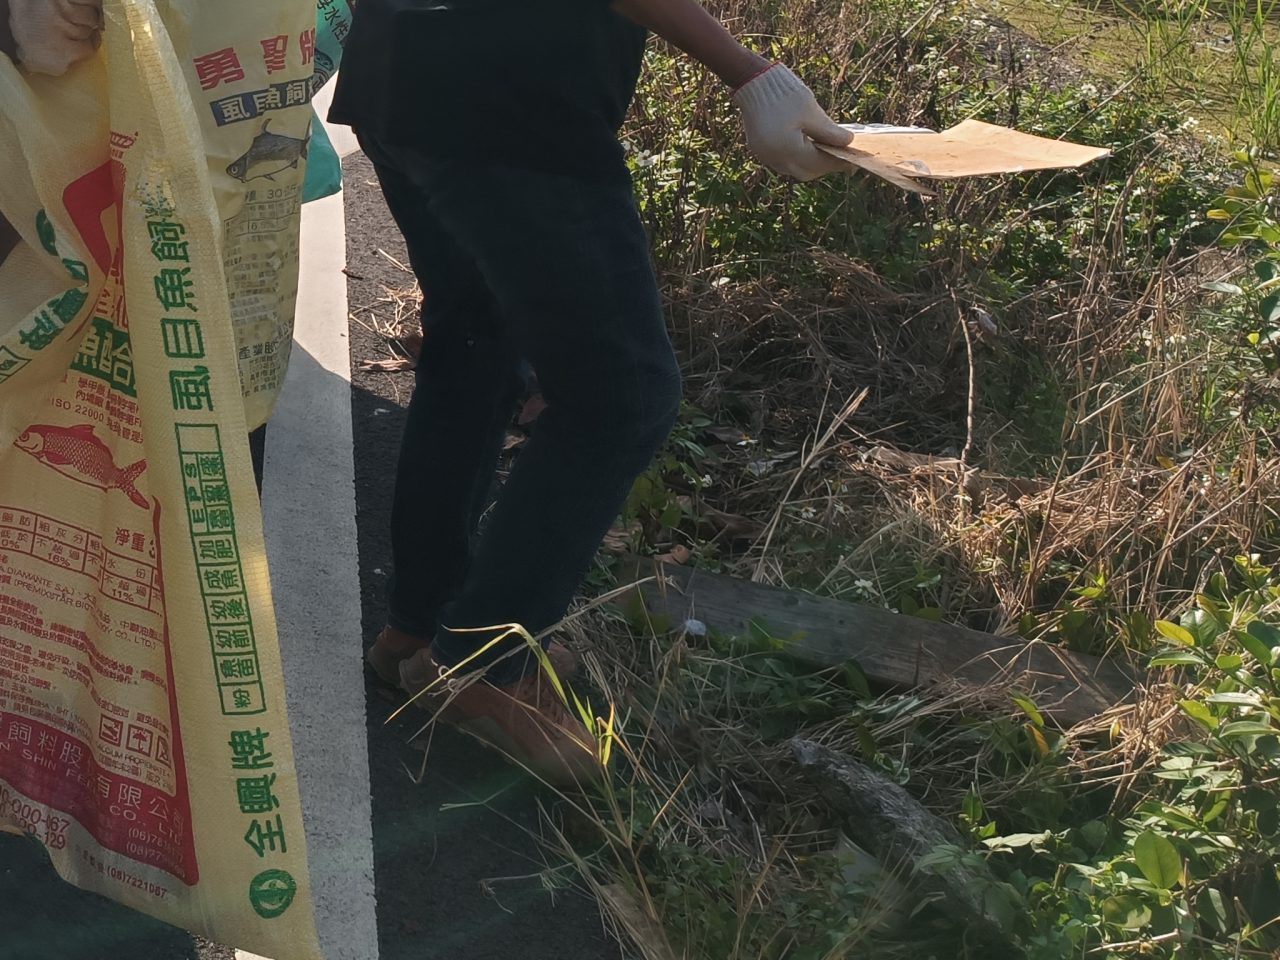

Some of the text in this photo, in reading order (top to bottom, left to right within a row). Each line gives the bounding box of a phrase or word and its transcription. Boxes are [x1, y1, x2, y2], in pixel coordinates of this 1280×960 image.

[52, 397, 104, 422] ISO 22000
[22, 748, 57, 771] SHIN
[228, 726, 288, 857] 全興牌
